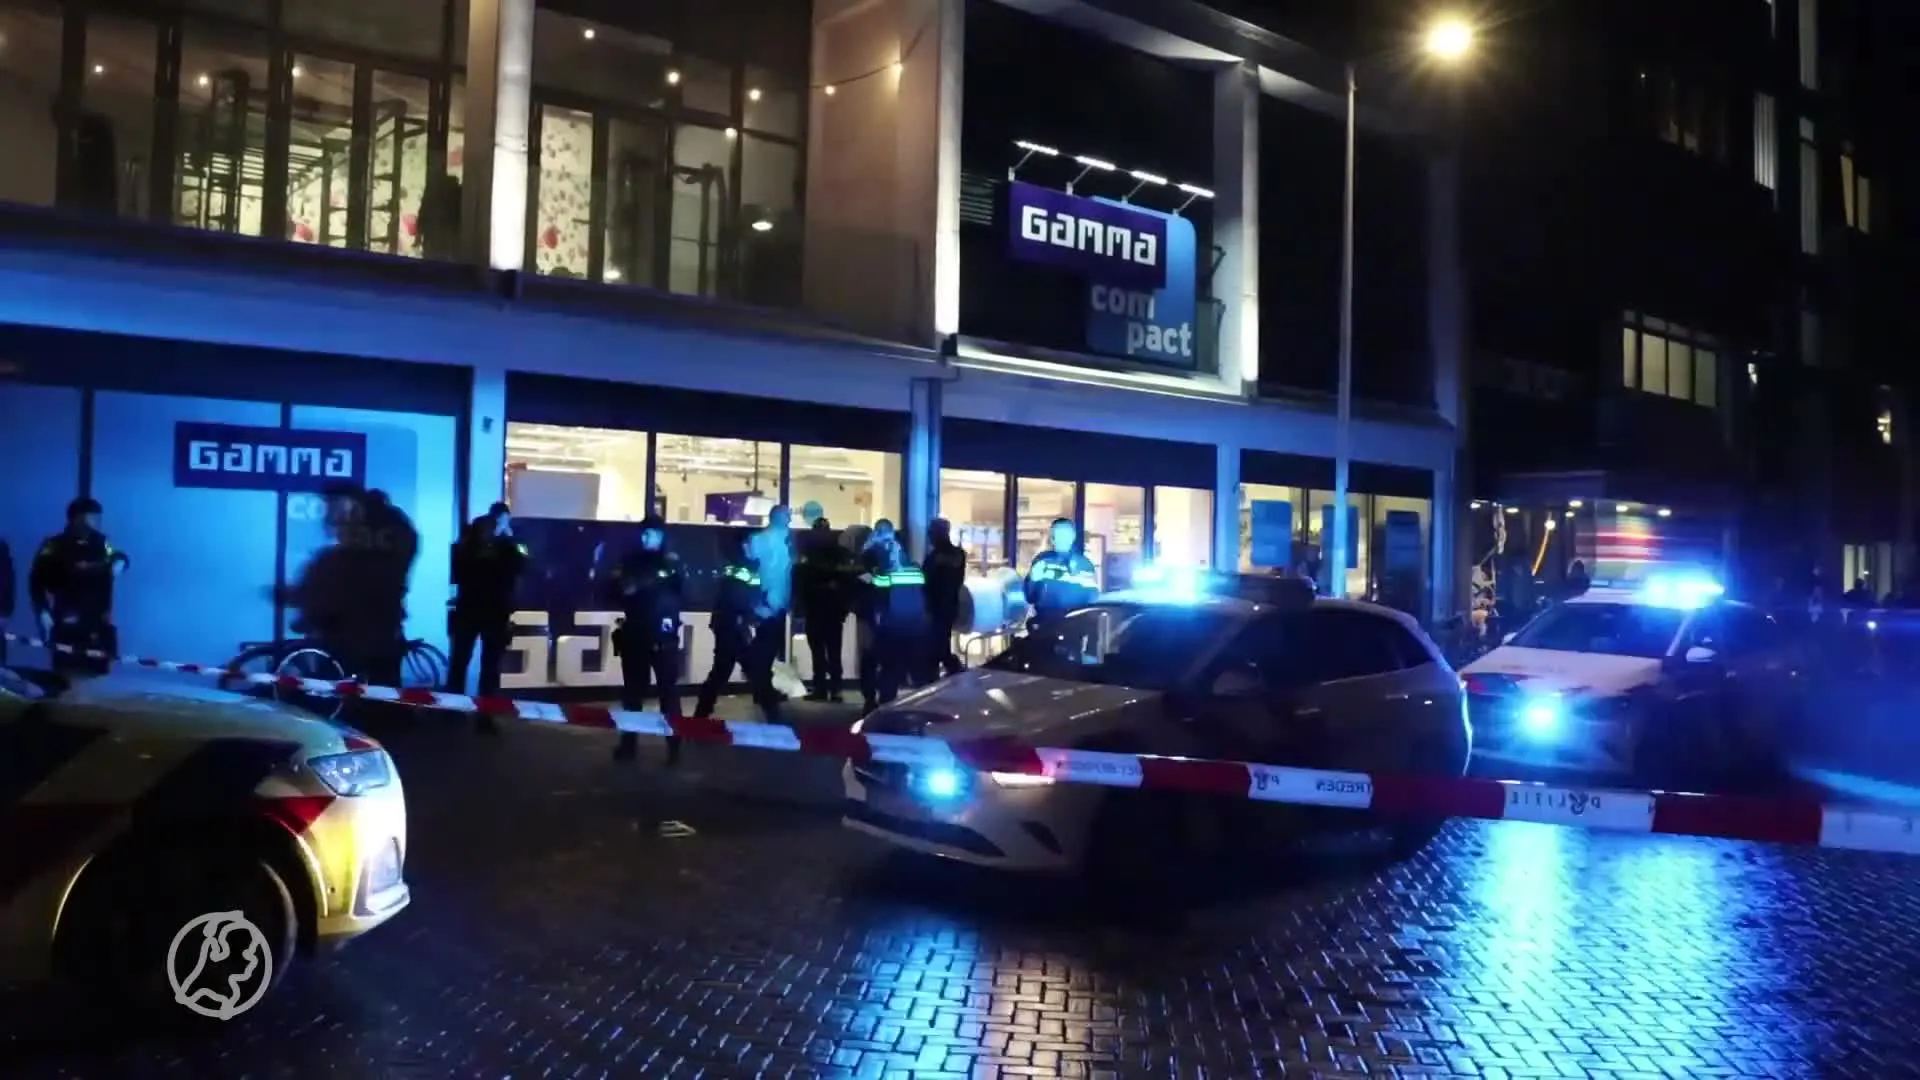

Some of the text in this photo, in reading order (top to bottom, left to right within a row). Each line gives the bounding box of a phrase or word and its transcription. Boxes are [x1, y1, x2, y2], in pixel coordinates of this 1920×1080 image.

[1021, 205, 1157, 266] GAMMA
[1091, 285, 1155, 319] com
[1127, 321, 1193, 357] pact
[189, 440, 353, 477] GAMMA
